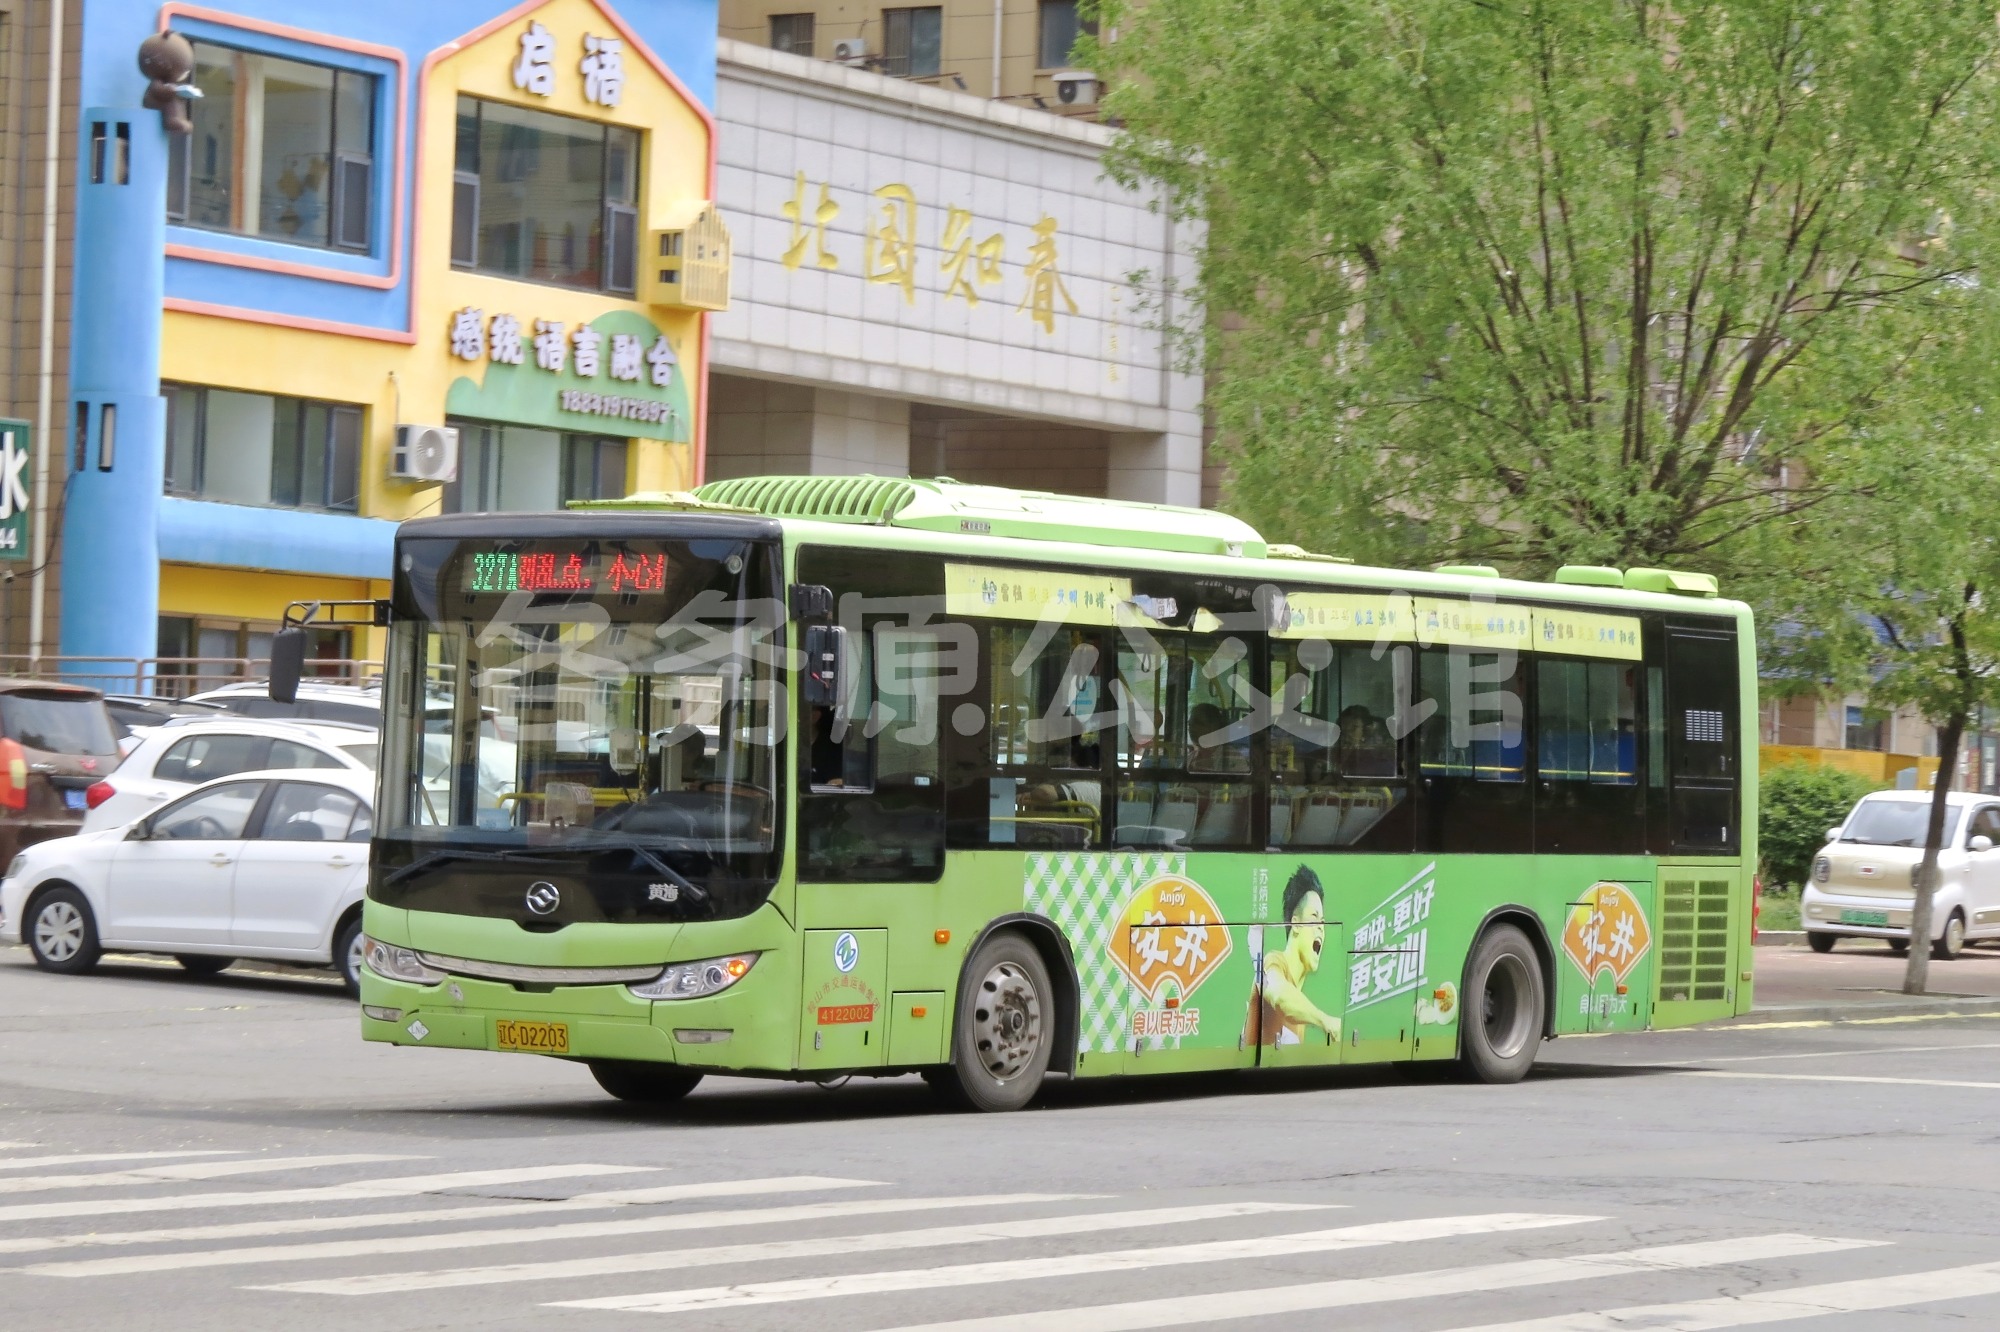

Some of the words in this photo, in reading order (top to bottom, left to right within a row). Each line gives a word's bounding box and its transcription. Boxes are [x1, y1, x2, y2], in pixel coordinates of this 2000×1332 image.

[512, 20, 623, 107] 启语
[782, 170, 1078, 333] 北国知春
[450, 306, 677, 387] 感统语言融合
[648, 883, 678, 901] 黄海
[1160, 890, 1186, 906] Anjoy
[1601, 892, 1619, 906] Anjoy
[1131, 910, 1208, 976] 安井
[1579, 910, 1634, 965] 安井
[1347, 928, 1427, 1007] 更安心
[821, 1007, 870, 1021] 4122002
[1132, 1009, 1200, 1036] 食以民为天
[1579, 994, 1628, 1014] 食以民为天
